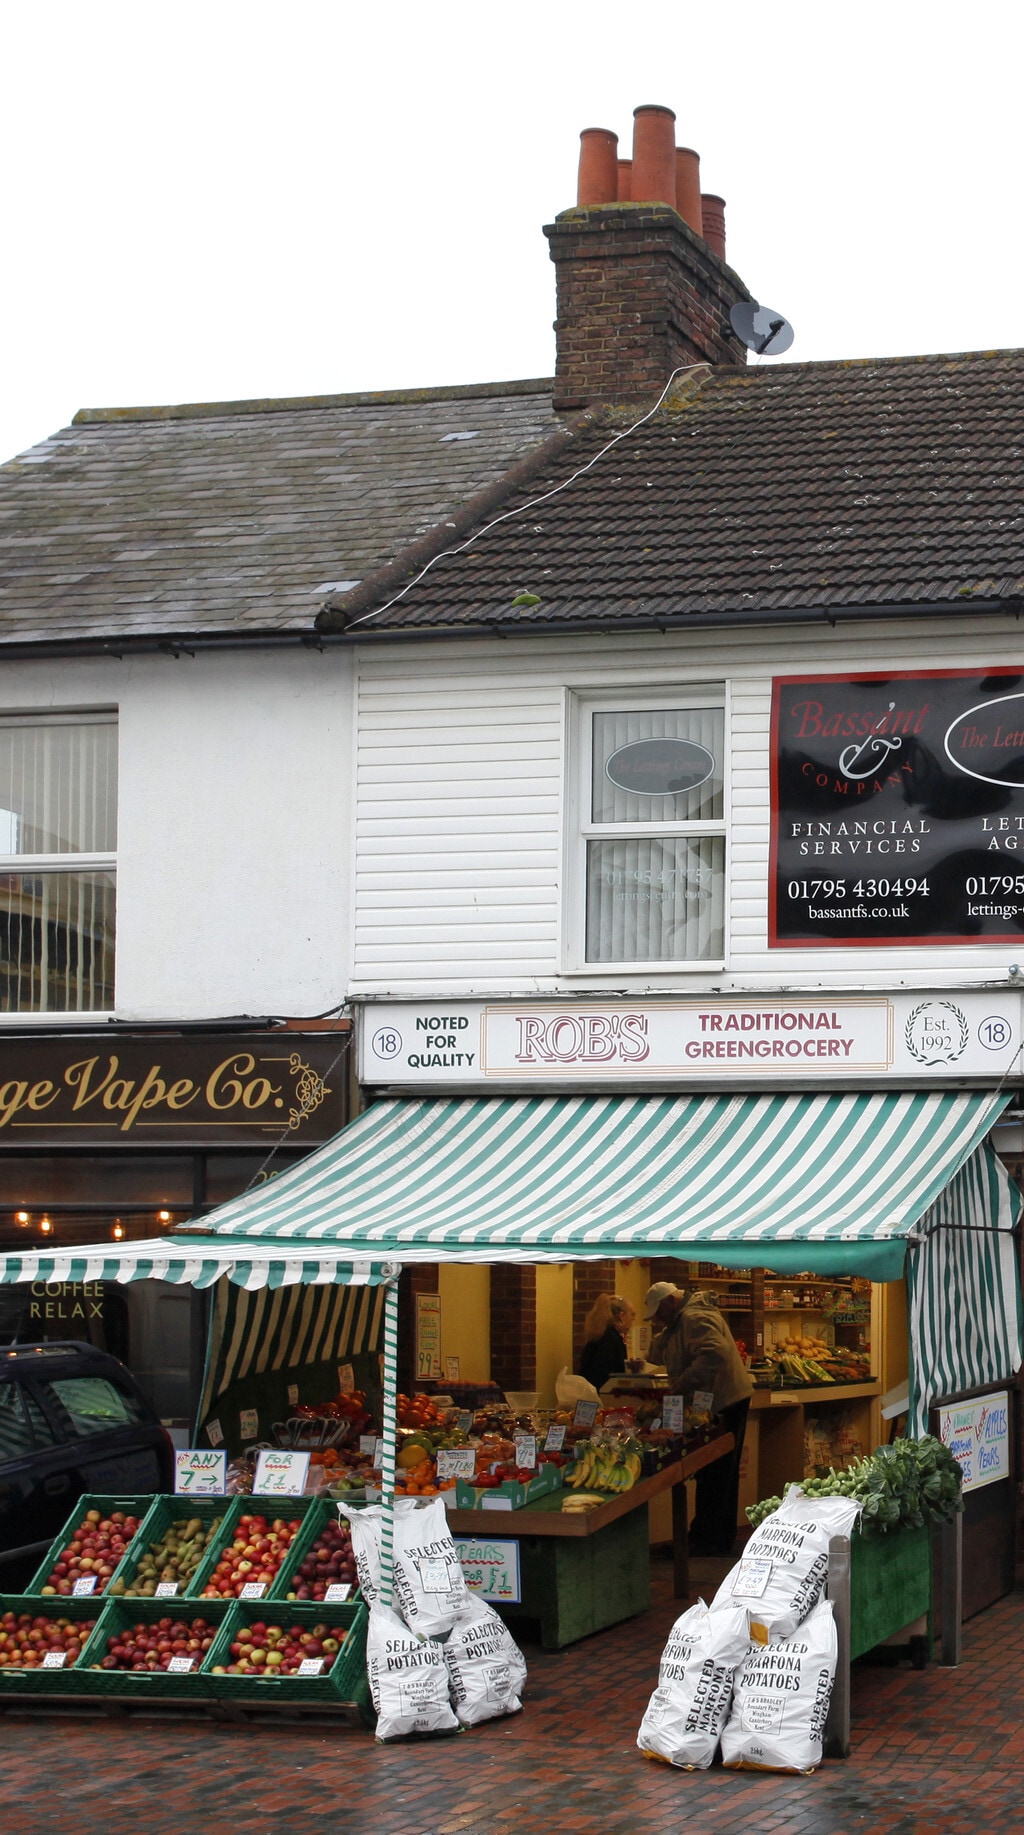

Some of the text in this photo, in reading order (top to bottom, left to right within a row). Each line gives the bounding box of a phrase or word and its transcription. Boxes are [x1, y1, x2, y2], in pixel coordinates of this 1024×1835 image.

[791, 700, 929, 738] Bassant
[960, 727, 988, 748] The
[801, 761, 914, 794] COMPANY
[791, 819, 930, 837] FINANCIAL
[800, 838, 921, 855] SERVICES
[607, 868, 713, 885] 01795 471757
[788, 877, 930, 899] 01795 430494
[808, 903, 910, 919] bassantfs.co.uk
[416, 1016, 469, 1031] NOTED
[698, 1012, 842, 1031] TRADITIONAL
[923, 1017, 950, 1031] Est.
[426, 1035, 456, 1049] FOR
[515, 1014, 650, 1063] ROB'S
[984, 1023, 1005, 1043] 18
[377, 1033, 397, 1053] 18
[685, 1039, 854, 1059] GREENGROCERY
[920, 1035, 952, 1051] 1992
[407, 1053, 475, 1068] QUALITY
[64, 1055, 201, 1131] Vape
[206, 1053, 284, 1110] Co.
[31, 1281, 104, 1297] COFFEE
[30, 1302, 104, 1318] RELAX
[190, 1453, 222, 1467] ANY
[265, 1453, 293, 1465] FOR
[181, 1471, 195, 1487] 7
[404, 1537, 455, 1558] SELECTED
[760, 1529, 804, 1549] MARFONA
[455, 1543, 505, 1560] PEARS
[749, 1542, 799, 1564] POTATOES
[393, 1561, 419, 1616] SELECTED
[790, 1553, 828, 1610] SELECTED
[387, 1652, 440, 1671] POTATOES
[664, 1644, 692, 1662] RFONA
[744, 1656, 801, 1672] MARFONA
[740, 1674, 801, 1692] POTATOES
[685, 1659, 715, 1733] SELECTED
[700, 1667, 726, 1732] MARFONA
[809, 1669, 829, 1742] SELECTED
